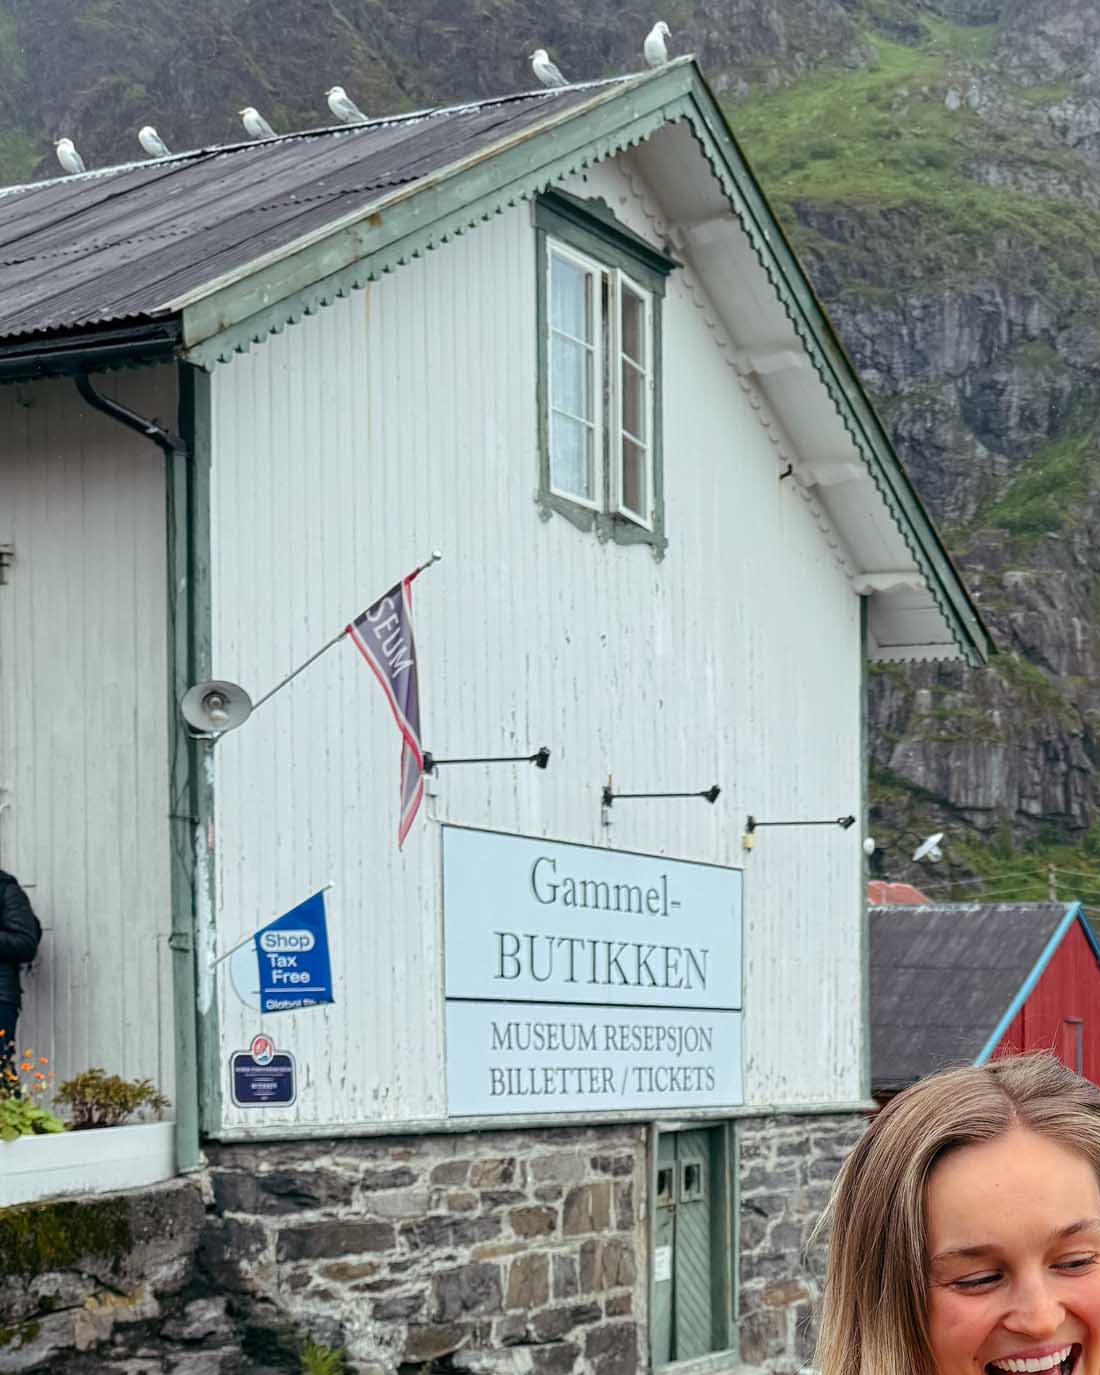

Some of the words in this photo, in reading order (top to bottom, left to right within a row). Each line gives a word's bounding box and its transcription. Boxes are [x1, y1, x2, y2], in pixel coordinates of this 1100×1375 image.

[530, 856, 681, 917] Gammel-
[264, 933, 311, 950] Shop
[267, 953, 298, 968] Tax
[493, 931, 709, 990] BUTIKKEN
[271, 969, 311, 984] Free
[491, 1022, 597, 1051] MUSEUM
[603, 1024, 713, 1056] RESEPSJON
[489, 1067, 616, 1096] BILLETTER
[621, 1067, 629, 1095] /
[632, 1066, 716, 1093] TICKETS
